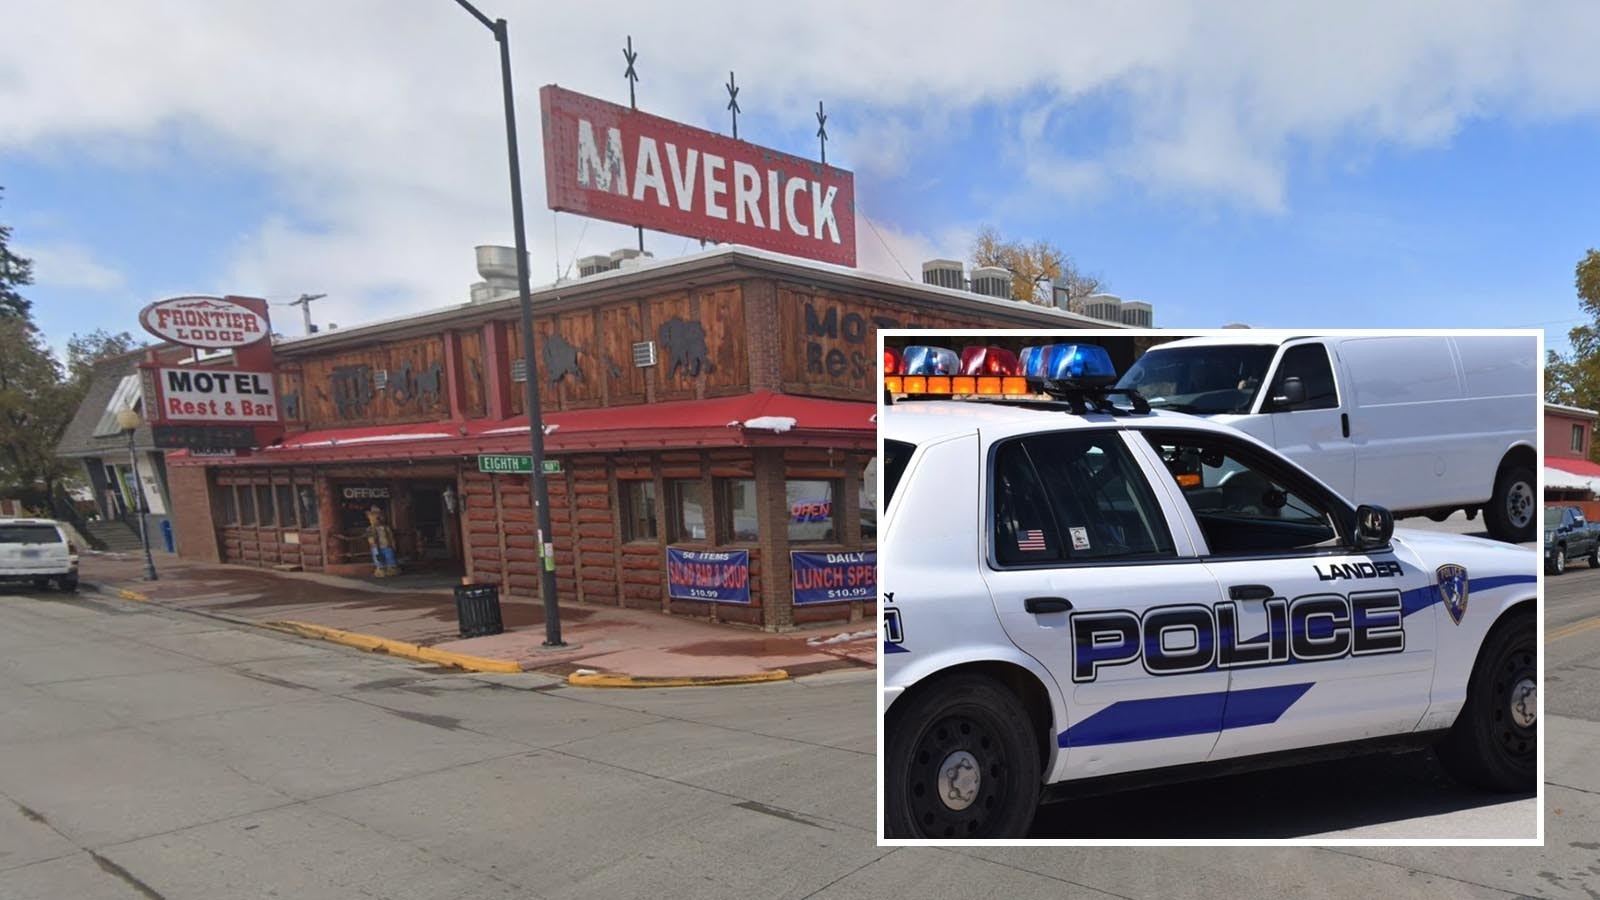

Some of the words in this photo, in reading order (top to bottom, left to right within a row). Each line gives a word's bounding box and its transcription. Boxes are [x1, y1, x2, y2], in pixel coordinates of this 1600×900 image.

[577, 118, 841, 244] MAVERICK
[156, 309, 260, 333] FRONTIER
[176, 328, 245, 342] LODGE
[167, 371, 269, 395] MOTEL
[168, 397, 218, 415] Rest
[224, 400, 236, 415] &
[241, 400, 273, 416] Bar
[484, 457, 519, 469] EIGHTH
[343, 487, 390, 499] OFFICE
[790, 503, 830, 517] OPEN
[682, 551, 695, 560] 50
[699, 552, 729, 561] ITEMS
[827, 552, 865, 563] DAILY
[670, 561, 694, 586] SALAD
[696, 563, 712, 587] BAR
[723, 564, 748, 589] SOUP
[794, 566, 843, 590] LUNCH
[1313, 560, 1404, 581] LANDER
[690, 589, 718, 598] $10.99
[827, 587, 867, 598] $10.99
[1069, 589, 1405, 683] POLICE
